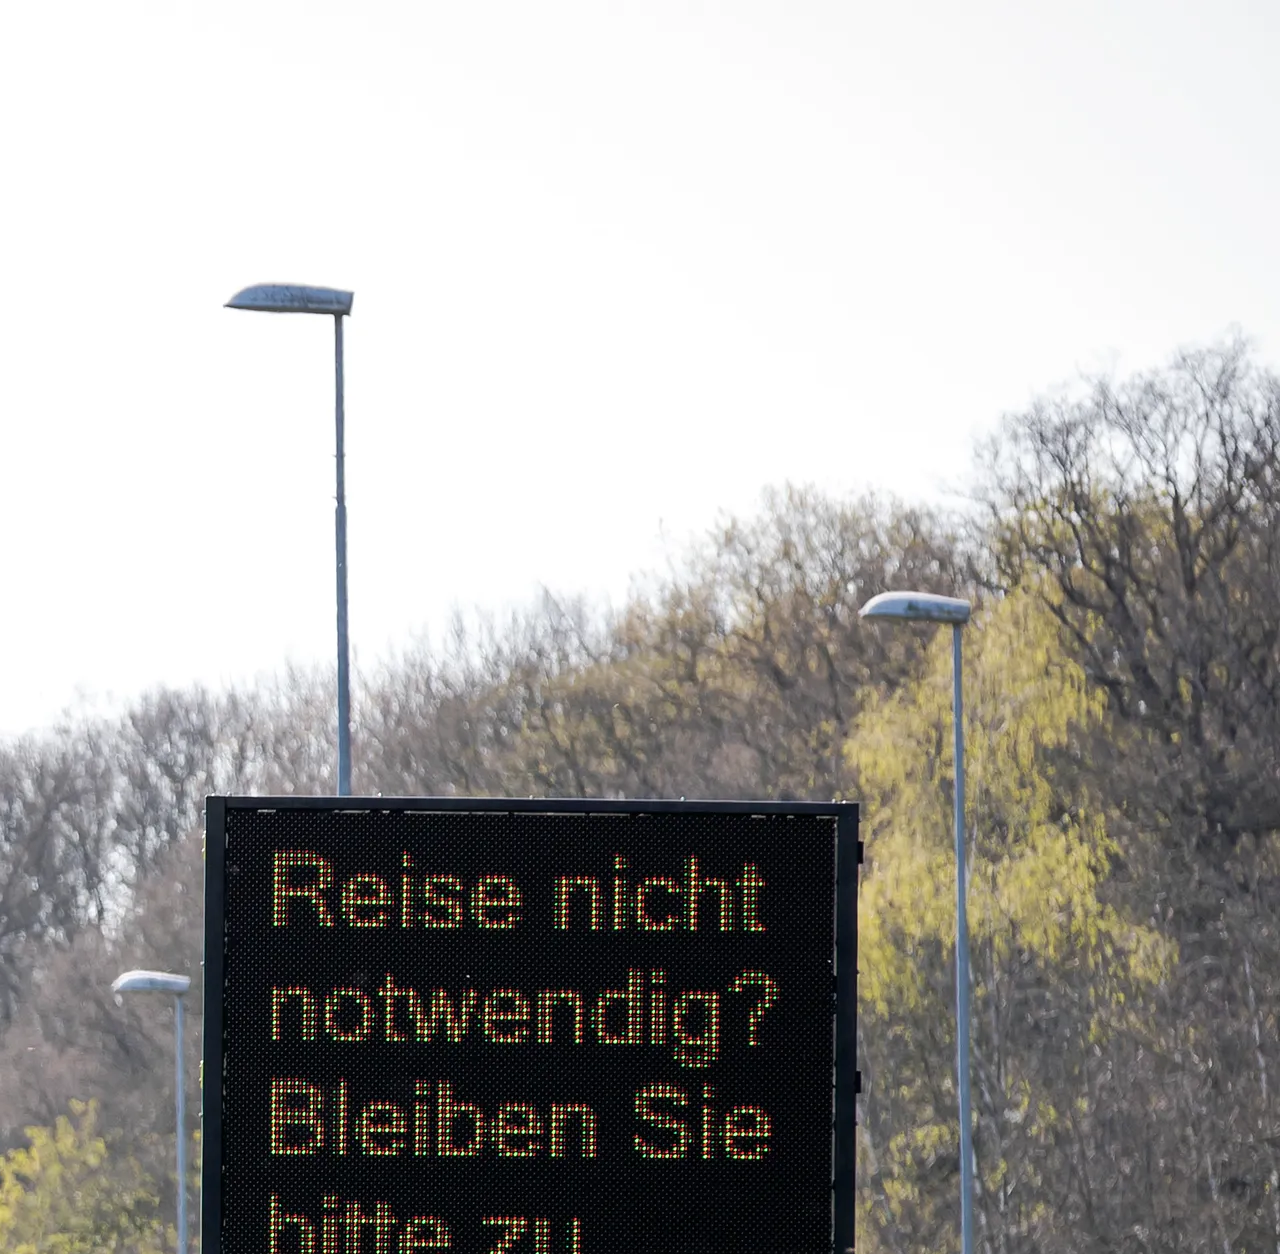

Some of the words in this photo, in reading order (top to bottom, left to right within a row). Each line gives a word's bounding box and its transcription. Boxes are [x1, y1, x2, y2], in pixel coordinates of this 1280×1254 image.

[273, 849, 523, 929] Reise
[554, 854, 766, 932] nicht
[272, 968, 781, 1068] notwendig?
[271, 1077, 597, 1158] Bleiben
[634, 1082, 773, 1160] Sie
